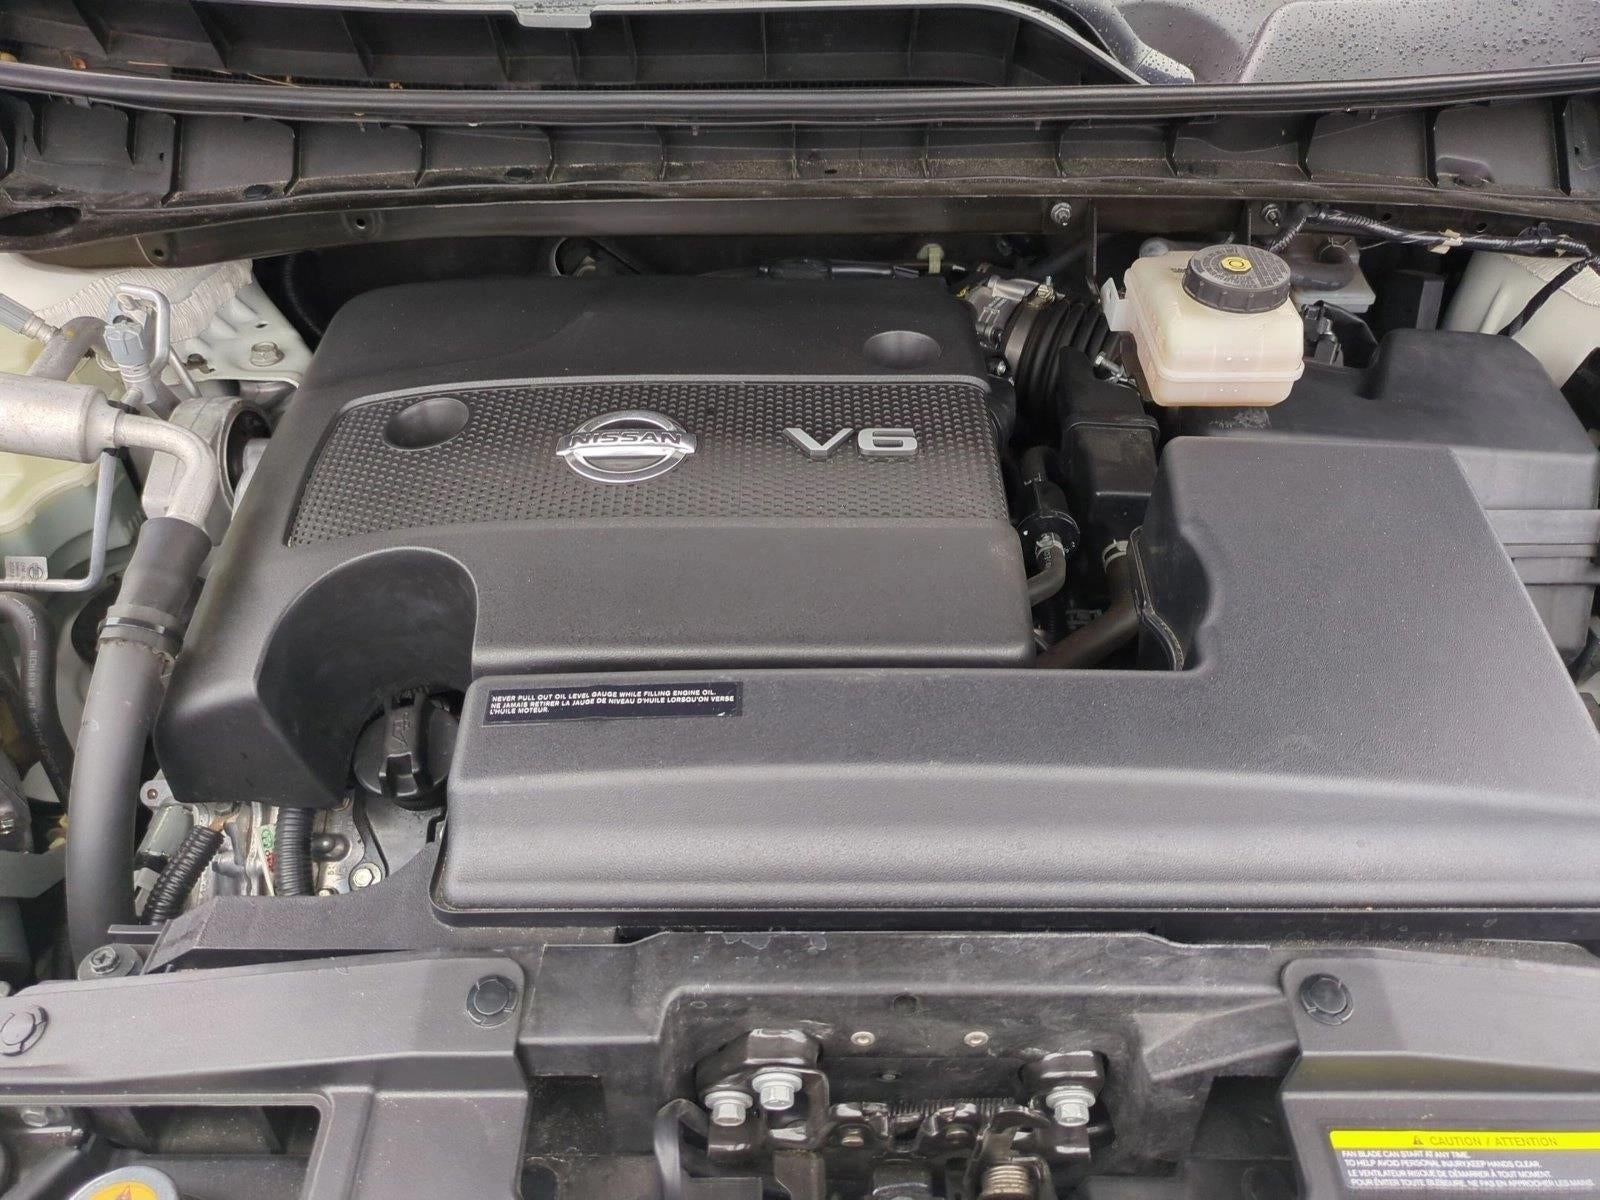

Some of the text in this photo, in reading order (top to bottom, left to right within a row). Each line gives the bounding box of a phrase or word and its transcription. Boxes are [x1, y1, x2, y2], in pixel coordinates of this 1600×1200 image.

[569, 431, 682, 446] NISSAN
[783, 427, 918, 461] V6
[490, 702, 502, 710] NE
[502, 701, 528, 709] JAMAIS
[529, 700, 560, 708] RETIRER
[596, 697, 607, 705] DE
[608, 697, 635, 705] NIVEAU
[636, 696, 666, 704] D'HUILE
[492, 695, 516, 703] NEVER
[517, 694, 535, 702] PULL
[537, 693, 553, 701] OUT
[568, 691, 590, 700] LEVEL
[591, 691, 618, 699] GAUGE
[1429, 1135, 1481, 1146] CAUTION
[1495, 1136, 1559, 1147] ATTENTION
[1341, 1150, 1358, 1158] FAN
[1358, 1150, 1382, 1158] BLADE
[1382, 1150, 1400, 1158] CAN
[1400, 1150, 1424, 1158] START
[1344, 1159, 1356, 1167] TO
[1356, 1159, 1377, 1167] HELP
[1377, 1159, 1400, 1167] AVOID
[1400, 1159, 1440, 1168] PERSONAL
[1347, 1169, 1359, 1177] LE
